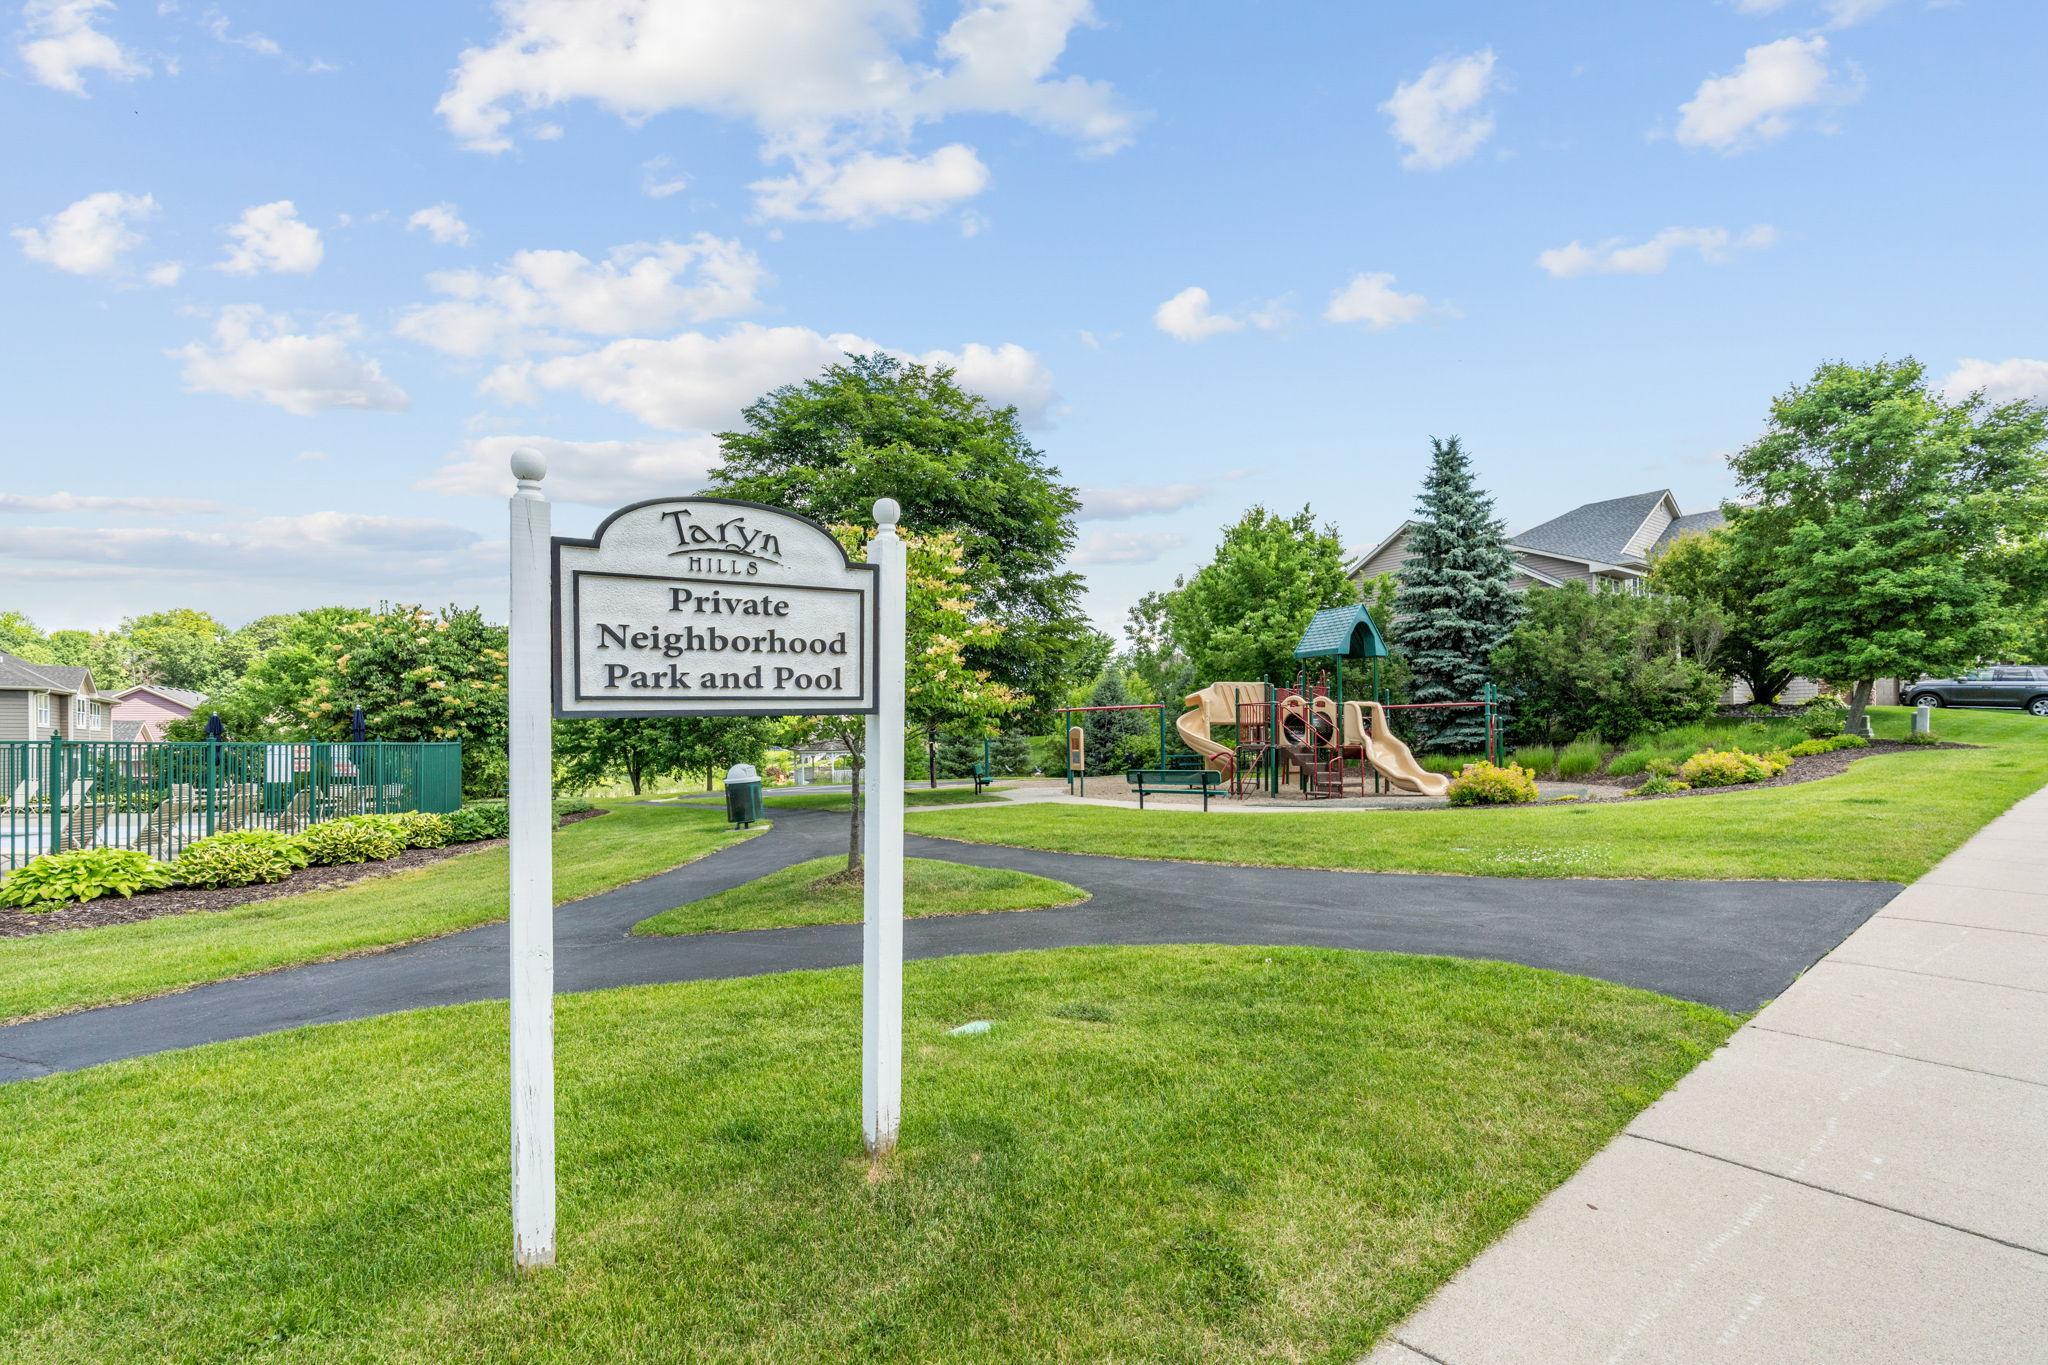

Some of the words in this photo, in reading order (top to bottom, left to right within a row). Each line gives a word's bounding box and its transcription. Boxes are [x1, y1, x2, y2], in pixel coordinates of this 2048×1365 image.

[662, 509, 782, 557] Taryn
[689, 556, 758, 576] HILLS
[669, 587, 790, 616] Private
[596, 623, 848, 658] Neighborhood
[604, 663, 692, 689] Park
[700, 665, 763, 689] and
[773, 666, 843, 690] Pool
